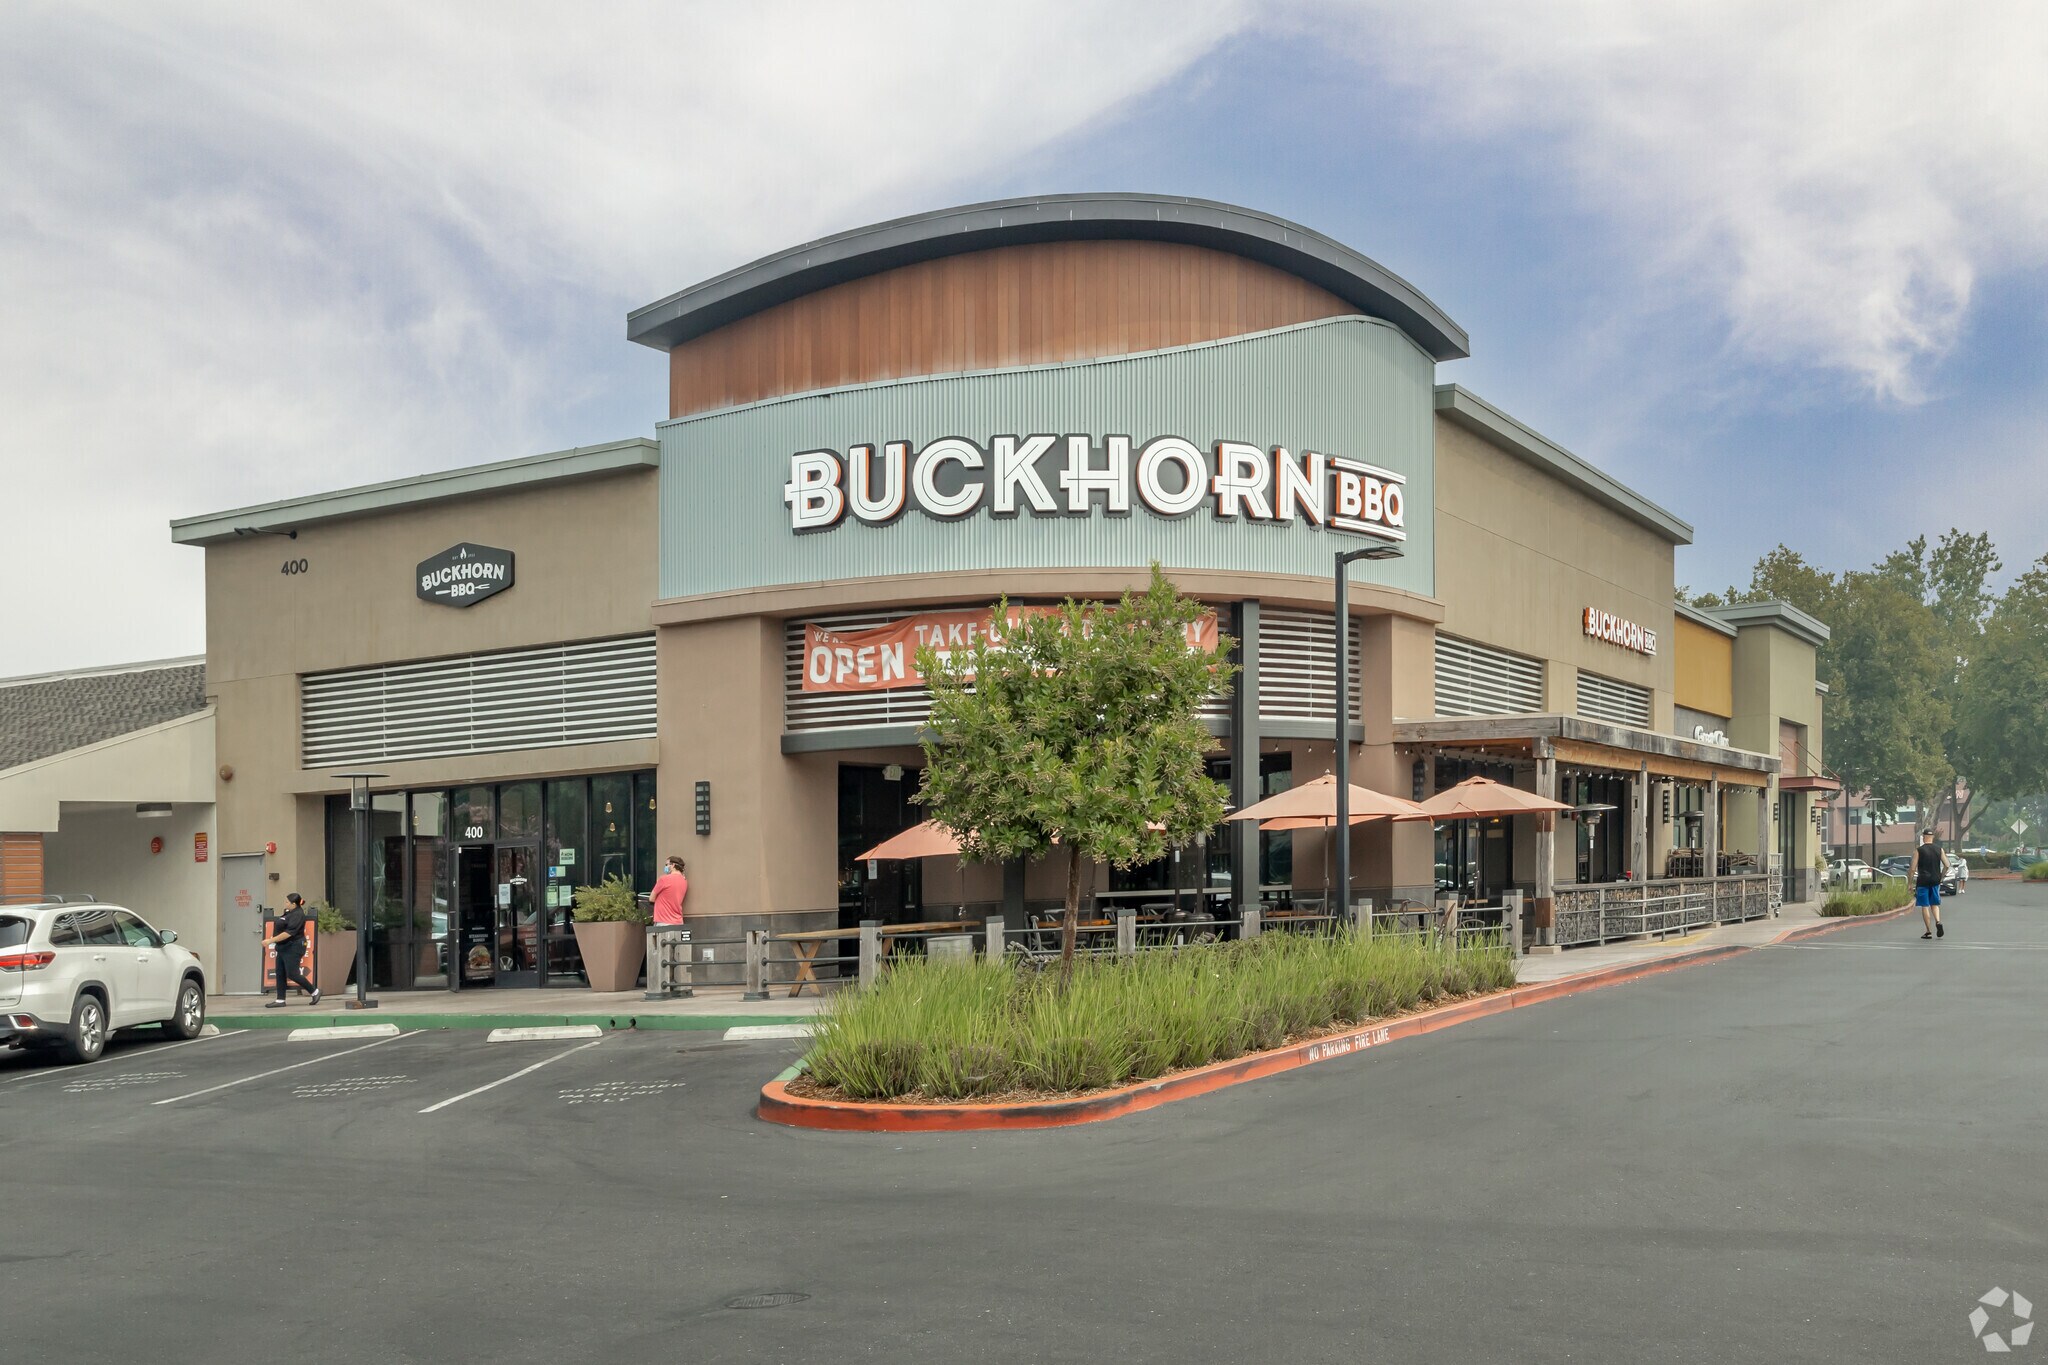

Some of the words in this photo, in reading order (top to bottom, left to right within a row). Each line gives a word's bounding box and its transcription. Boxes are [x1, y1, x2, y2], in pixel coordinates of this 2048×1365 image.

[784, 436, 1325, 529] BUCKHORN
[1335, 470, 1404, 527] BBQ
[281, 558, 308, 576] 400
[422, 562, 505, 591] BUCKHORN
[450, 582, 475, 597] BBQ
[813, 630, 830, 643] WE
[914, 616, 1034, 647] TAKE-O
[1585, 606, 1645, 651] BUCKHORN
[1645, 632, 1657, 651] BBQ
[809, 641, 905, 684] OPEN
[465, 826, 484, 839] 400
[1309, 1046, 1320, 1061] NO
[1322, 1038, 1351, 1057] PARKING
[1354, 1032, 1371, 1050] FIRE
[1372, 1028, 1390, 1044] LANE
